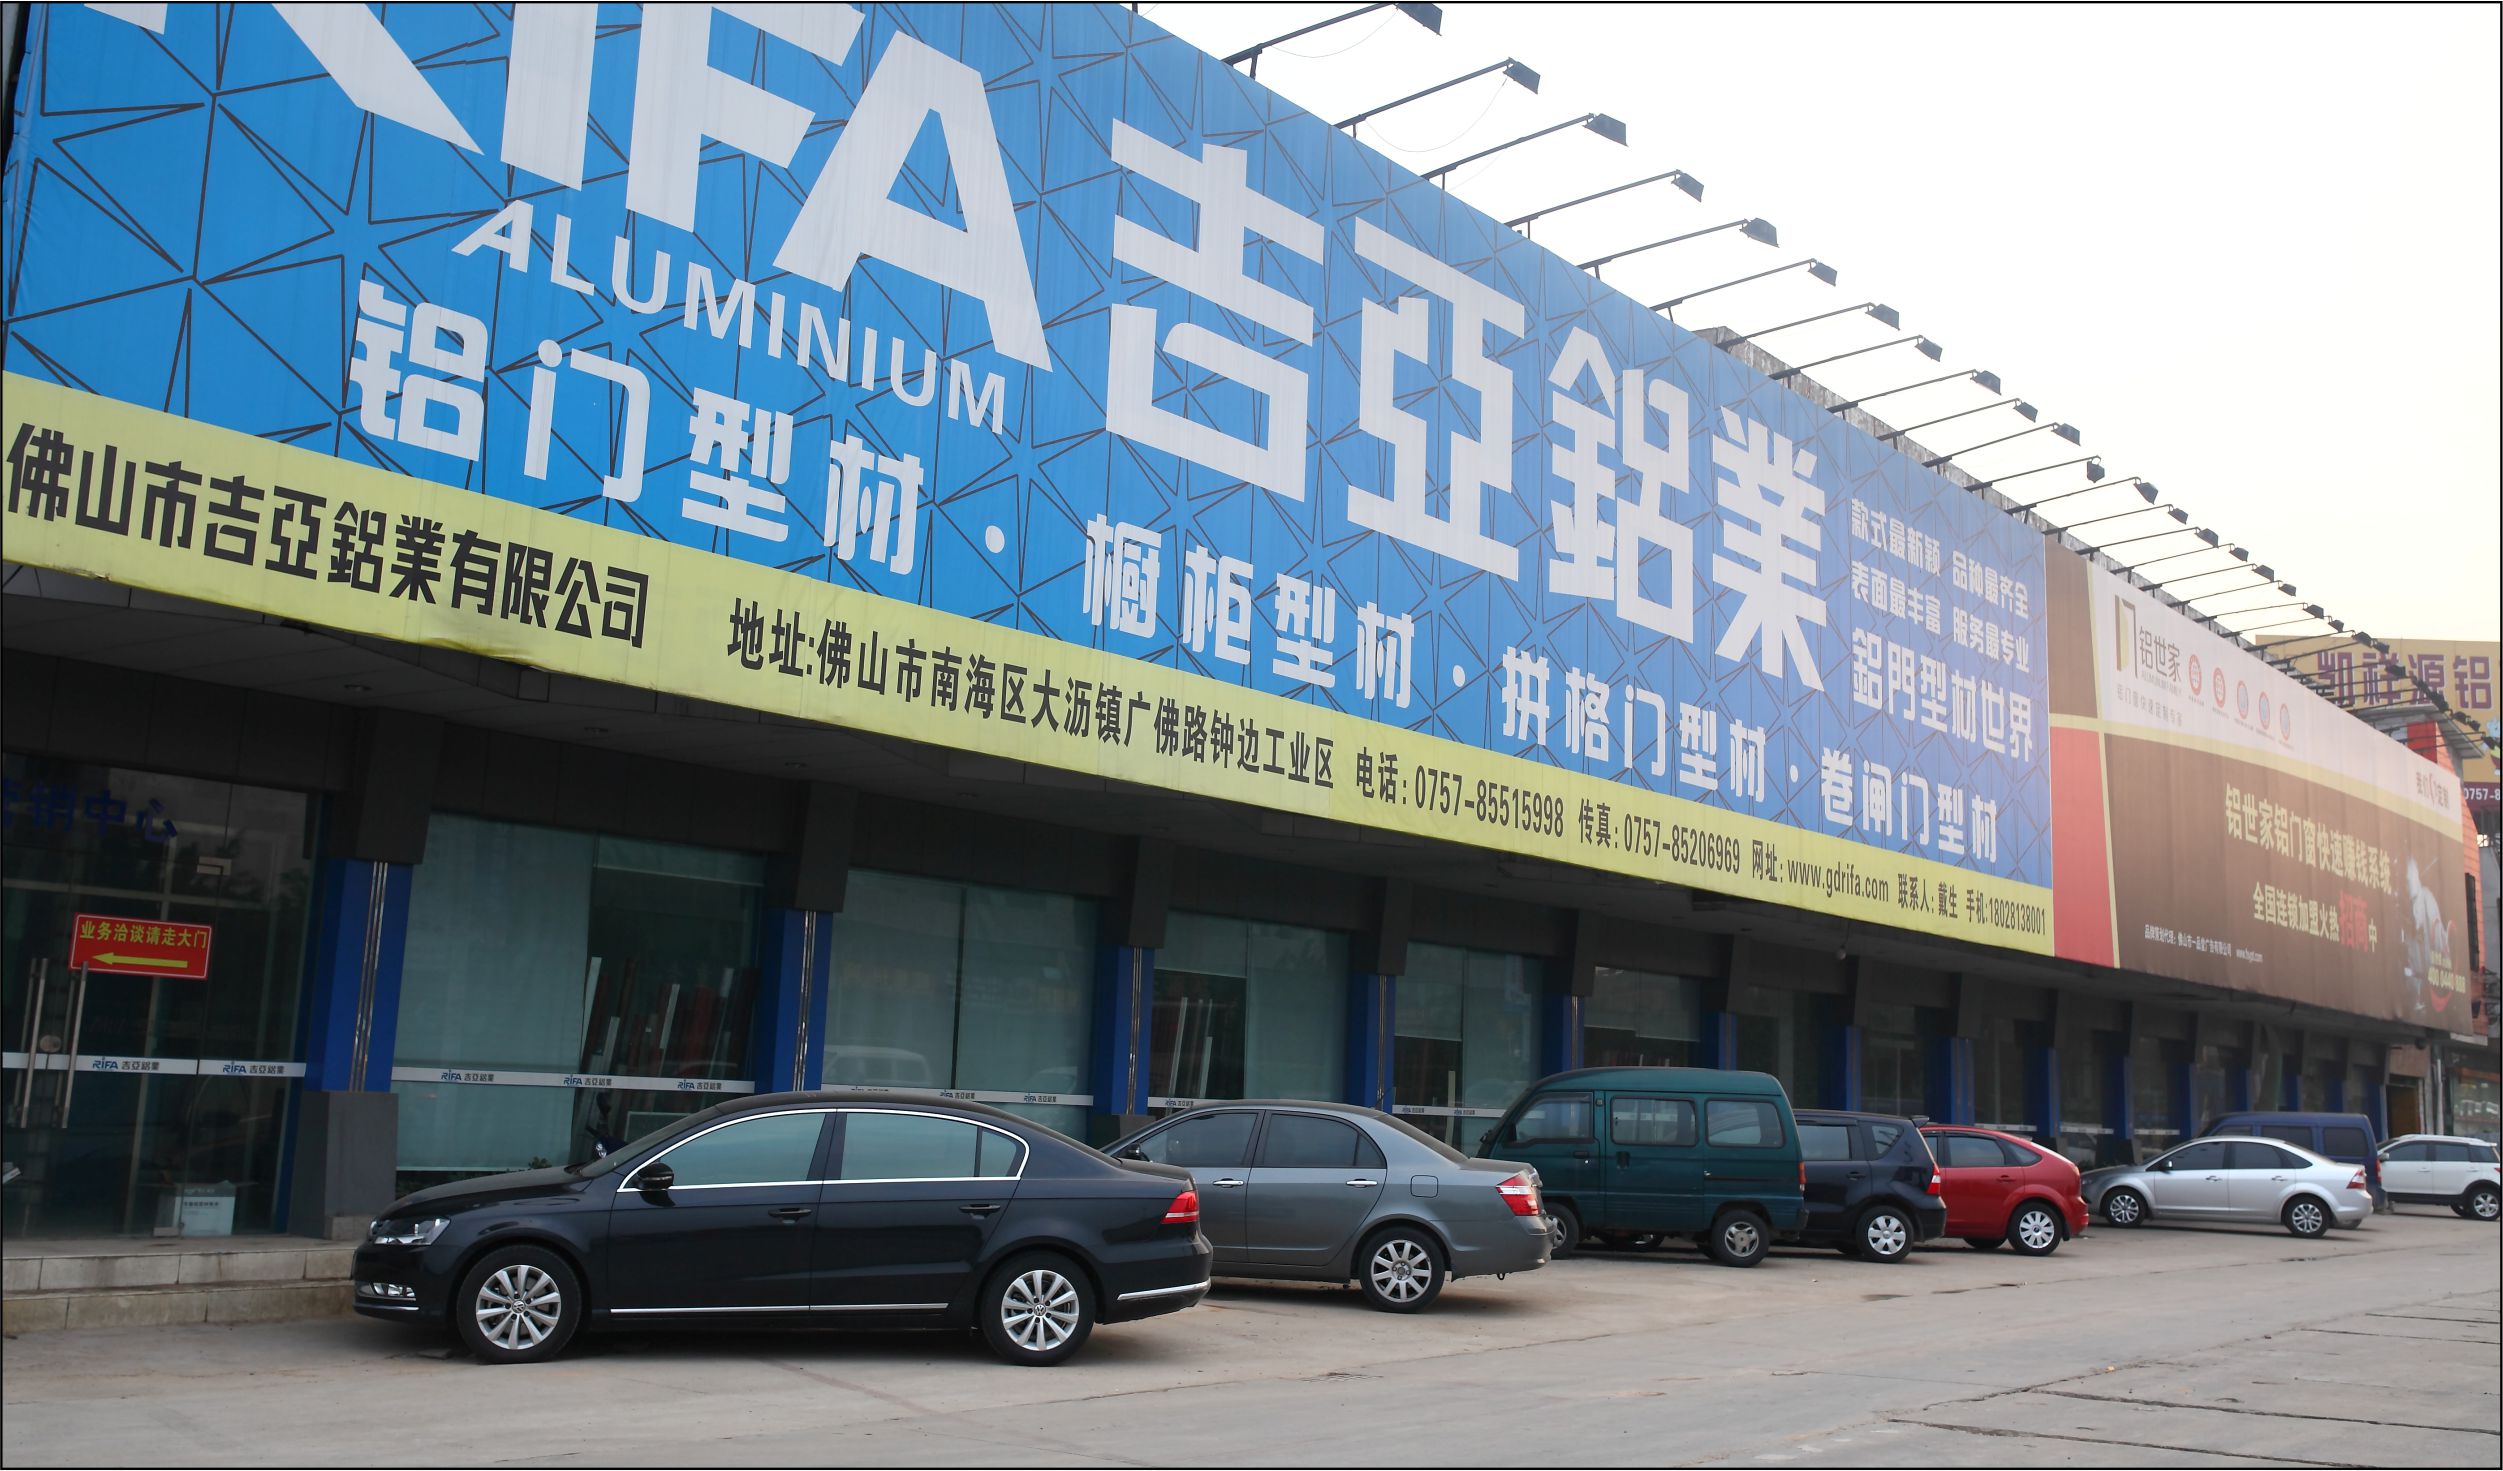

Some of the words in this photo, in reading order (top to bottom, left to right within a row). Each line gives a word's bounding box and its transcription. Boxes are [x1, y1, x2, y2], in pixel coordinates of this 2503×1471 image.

[452, 199, 1006, 435] ALUMINIUM
[348, 280, 925, 576] 铝门型材
[1082, 513, 1415, 709] 橱柜型材
[1501, 645, 1766, 804] 拼格门型材
[1820, 746, 1998, 864] 卷闸门型材
[1850, 497, 1941, 577] 款式最新颖
[1952, 549, 2029, 620] 品种最齐全
[1850, 559, 1942, 636] 表面最丰富
[1952, 605, 2030, 673] 服务最专业
[2138, 625, 2183, 683] 铝世家
[80, 919, 208, 950] 业务洽谈请走大门
[92, 1056, 118, 1071] RIFA
[222, 1061, 247, 1075] RIFA
[440, 1069, 462, 1082] RIFA
[562, 1073, 583, 1087] RIFA
[676, 1078, 695, 1091] RIFA
